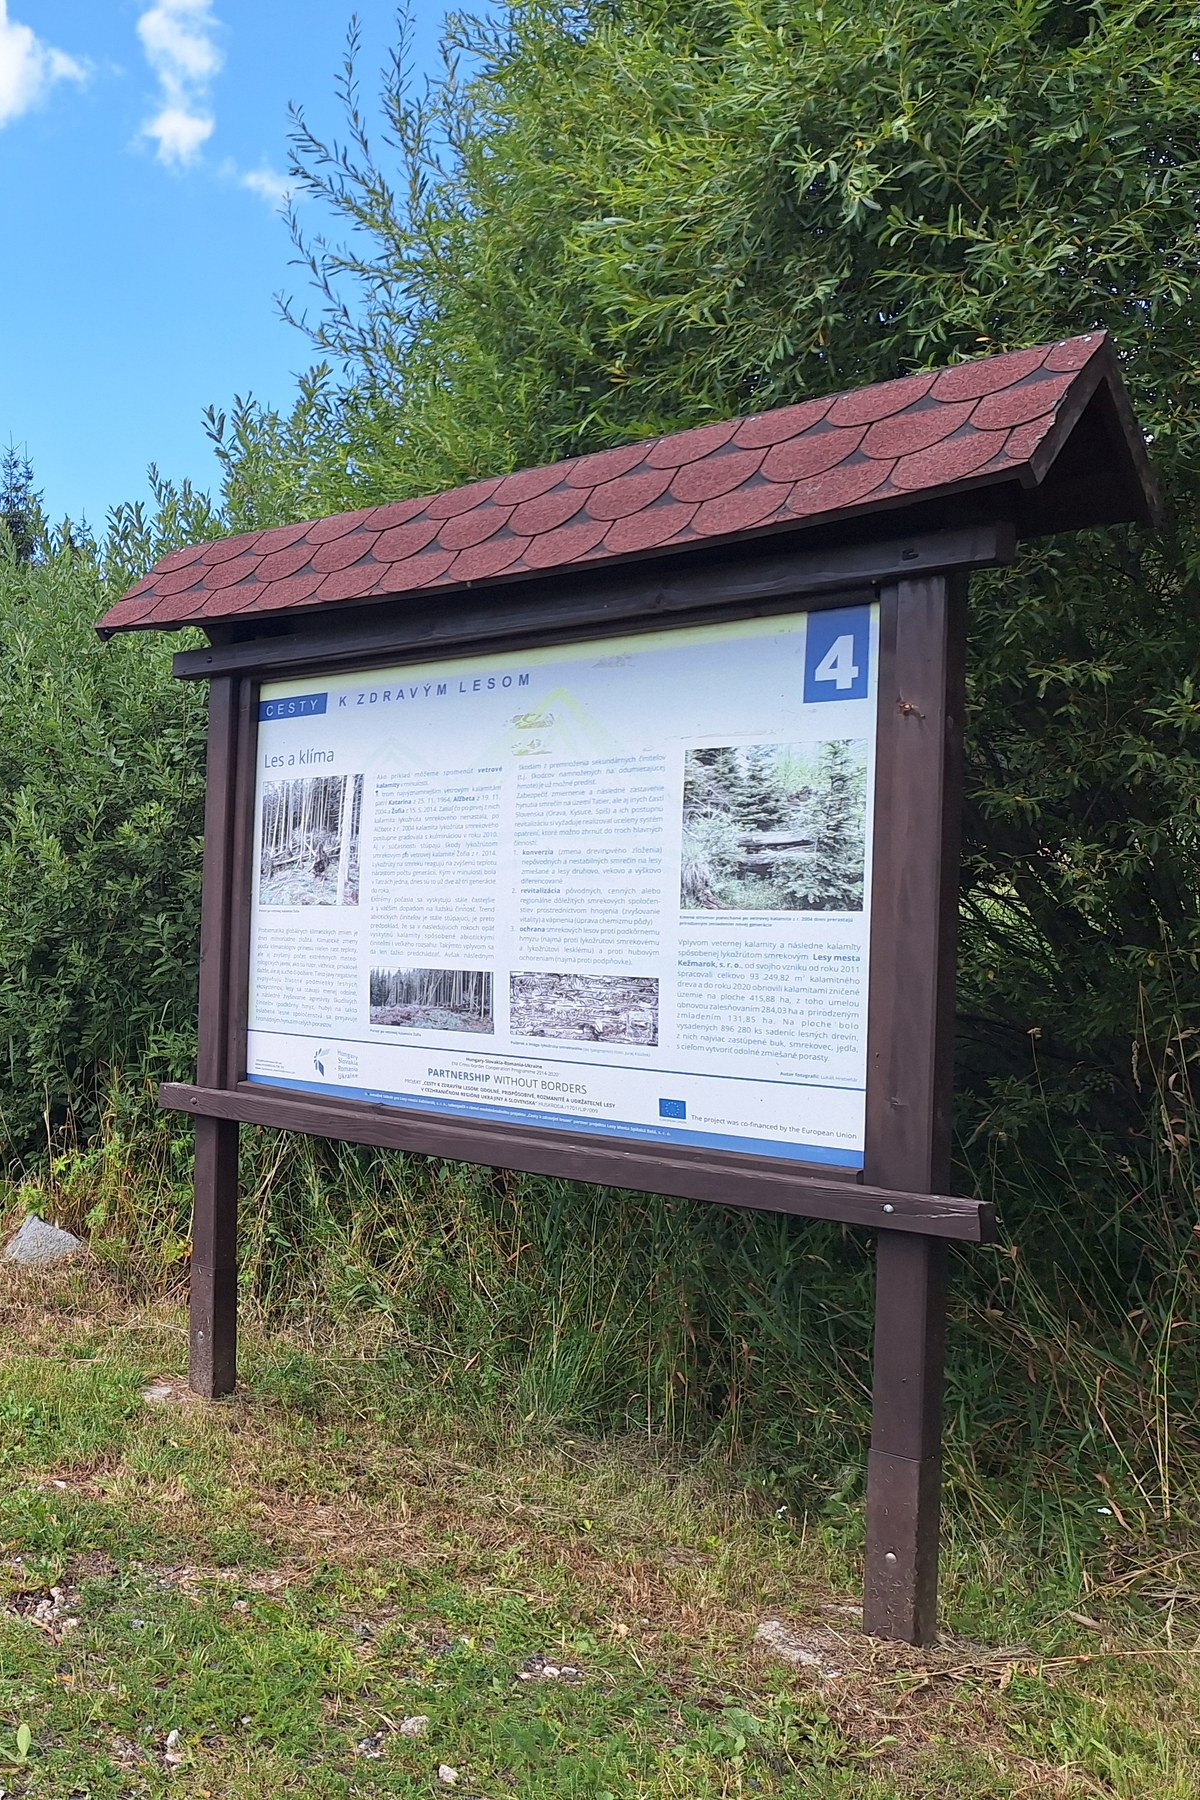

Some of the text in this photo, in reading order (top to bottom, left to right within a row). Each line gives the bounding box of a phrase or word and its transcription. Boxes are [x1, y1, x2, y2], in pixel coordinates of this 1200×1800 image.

[814, 634, 860, 690] 4
[266, 673, 530, 717] CESTY K ZDRAVÝM LESOM
[264, 748, 334, 768] Les a klíma
[678, 938, 708, 948] Vplyvom
[711, 939, 742, 949] veternej
[744, 940, 776, 950] kalamity
[826, 943, 861, 953] kalamity
[677, 959, 718, 968] Kežmarok,
[755, 962, 781, 972] svojho
[764, 952, 808, 962] smrekovým
[812, 953, 832, 963] Lesy
[677, 970, 713, 980] spracovali
[763, 974, 790, 982] 249,82
[809, 976, 860, 984] kalamitného
[784, 985, 827, 994] kalamitami
[829, 988, 860, 996] zničené
[720, 993, 745, 1002] ploche
[749, 994, 775, 1003] 415,88
[779, 996, 792, 1004] ha,
[828, 999, 860, 1007] umelou
[676, 1001, 708, 1009] obnovou
[761, 1006, 786, 1015] 284,03
[807, 1009, 859, 1020] prirodzeným
[676, 1011, 721, 1020] zmladením
[728, 1015, 756, 1024] 131,85
[801, 1019, 832, 1030] ploche
[676, 1022, 718, 1033] vysadených
[798, 1030, 828, 1041] lesných
[700, 1034, 726, 1044] najviac
[727, 1036, 767, 1047] zastúpené
[769, 1039, 786, 1048] buk,
[788, 1041, 834, 1052] smrekovec,
[733, 1047, 760, 1056] odolné
[760, 1049, 797, 1058] zmiešané
[798, 1052, 830, 1063] porasty.
[427, 1067, 588, 1094] PARTNERSHIP WITHOUT BORDERS
[536, 1094, 565, 1102] ROZMANITÉ
[704, 1116, 725, 1125] project
[740, 1120, 778, 1130] co-financed
[779, 1124, 788, 1133] by
[801, 1127, 834, 1138] European
[836, 1131, 857, 1139] Union
